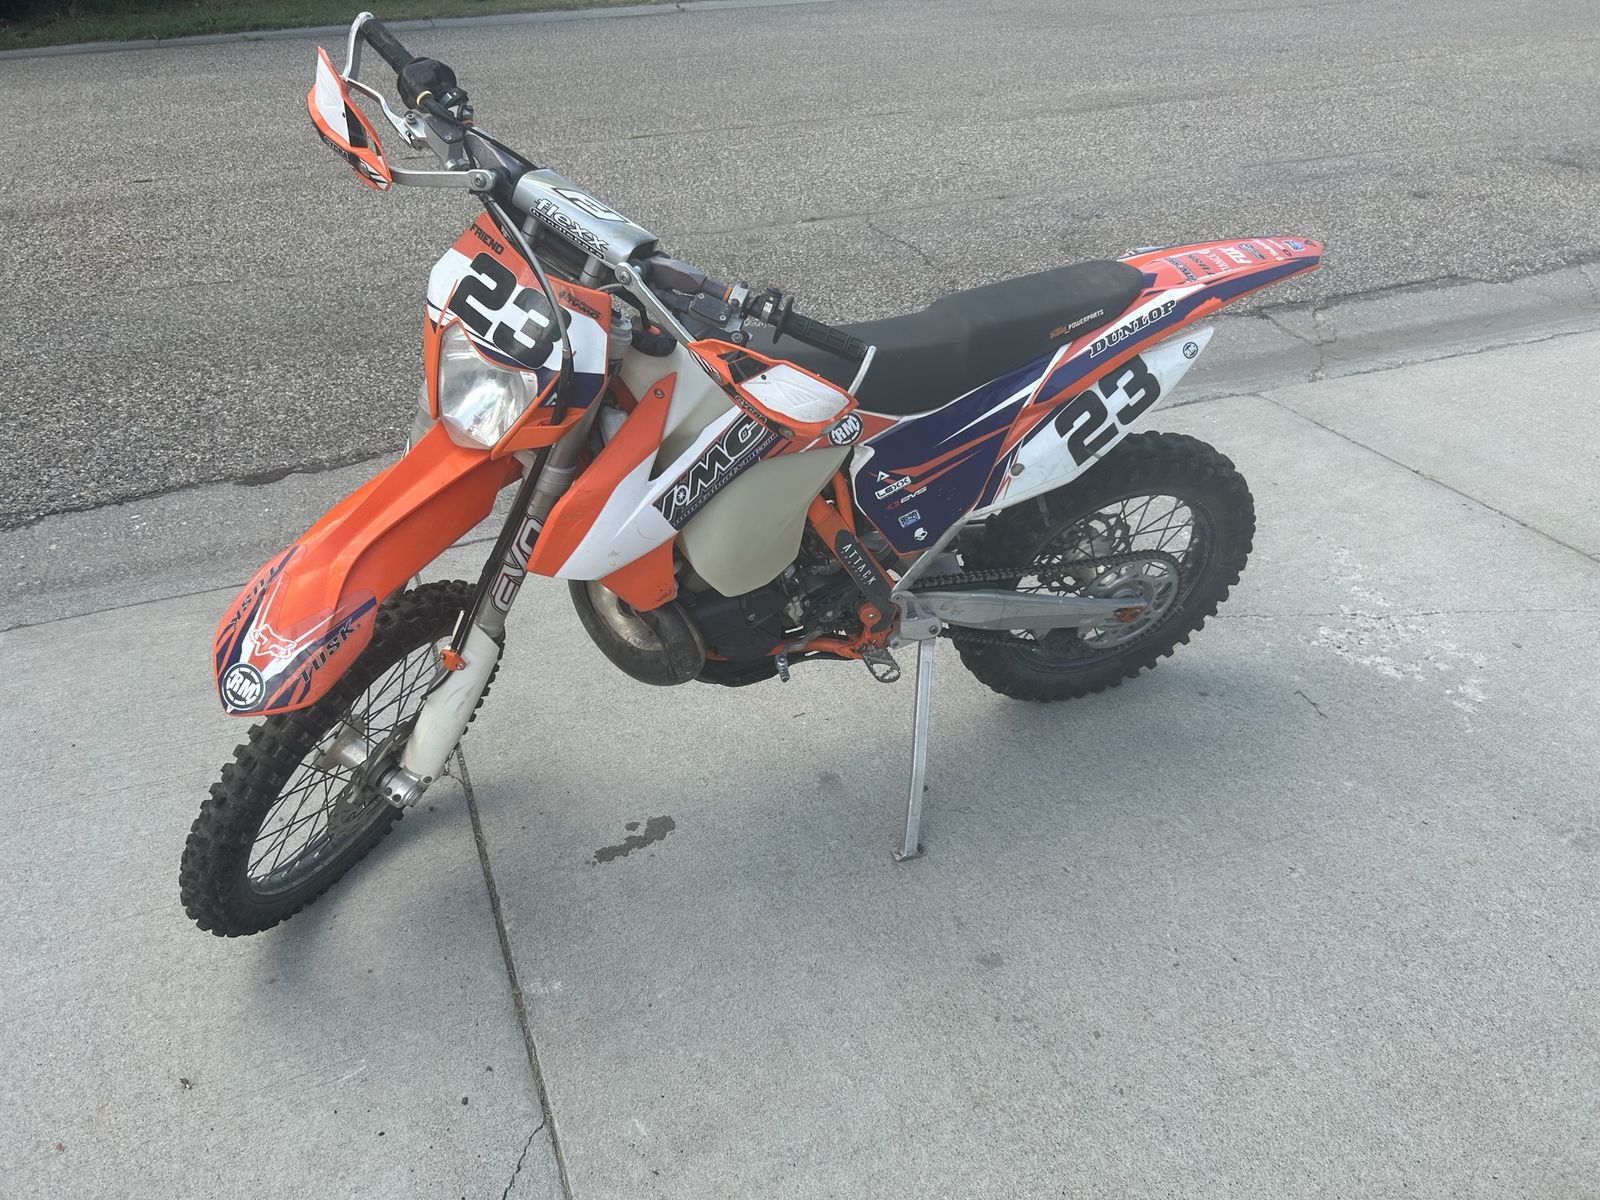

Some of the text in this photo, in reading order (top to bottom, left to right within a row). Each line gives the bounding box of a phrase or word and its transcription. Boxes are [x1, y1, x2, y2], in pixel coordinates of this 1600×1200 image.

[470, 223, 504, 255] FRIEND
[534, 198, 609, 251] flexx
[448, 251, 572, 369] 23
[1089, 299, 1176, 358] DUNLOP
[1054, 354, 1161, 467] 23
[843, 543, 876, 586] ATTACK
[299, 618, 355, 685] TUSK
